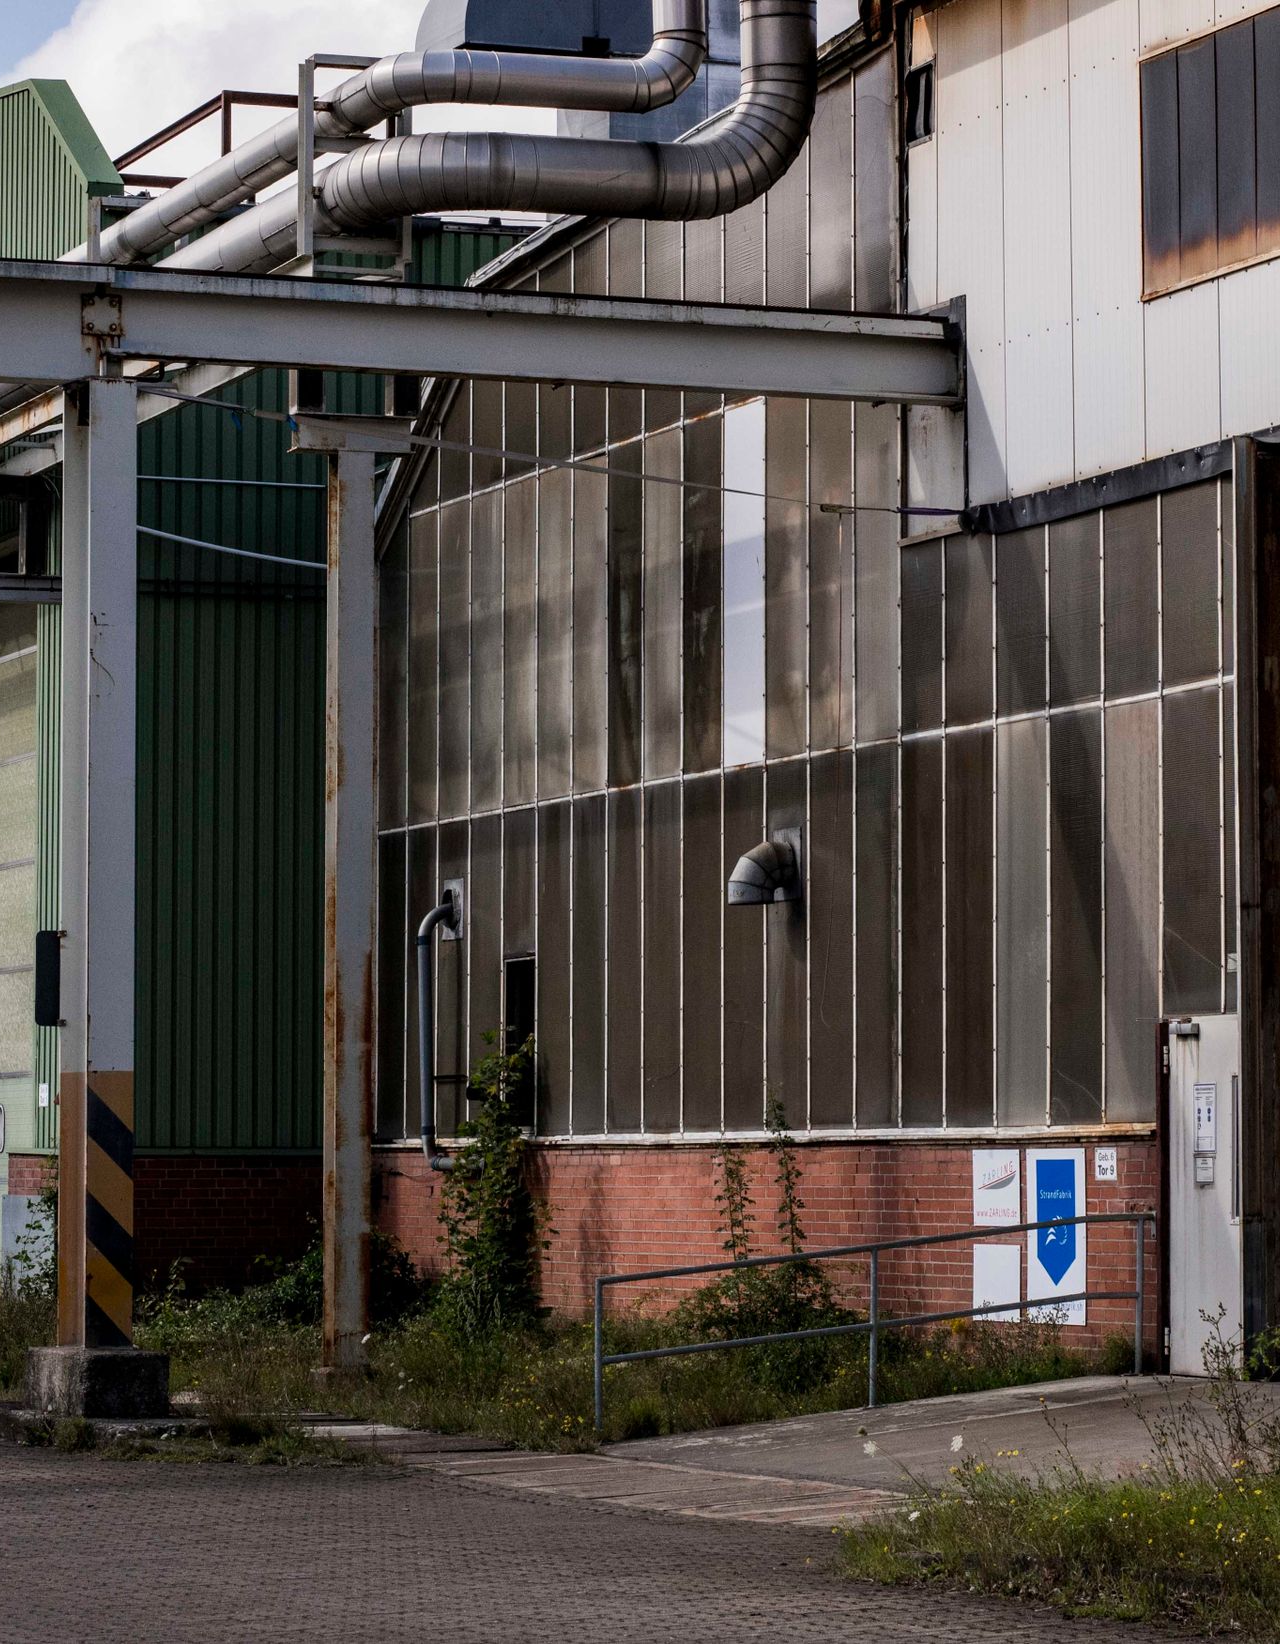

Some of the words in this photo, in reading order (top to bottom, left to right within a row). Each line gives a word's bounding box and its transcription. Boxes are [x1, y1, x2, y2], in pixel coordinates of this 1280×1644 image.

[982, 1161, 1013, 1182] ZARLING
[1098, 1164, 1108, 1176] Tor
[1110, 1164, 1115, 1176] 9
[1040, 1189, 1072, 1199] StrandFabrik
